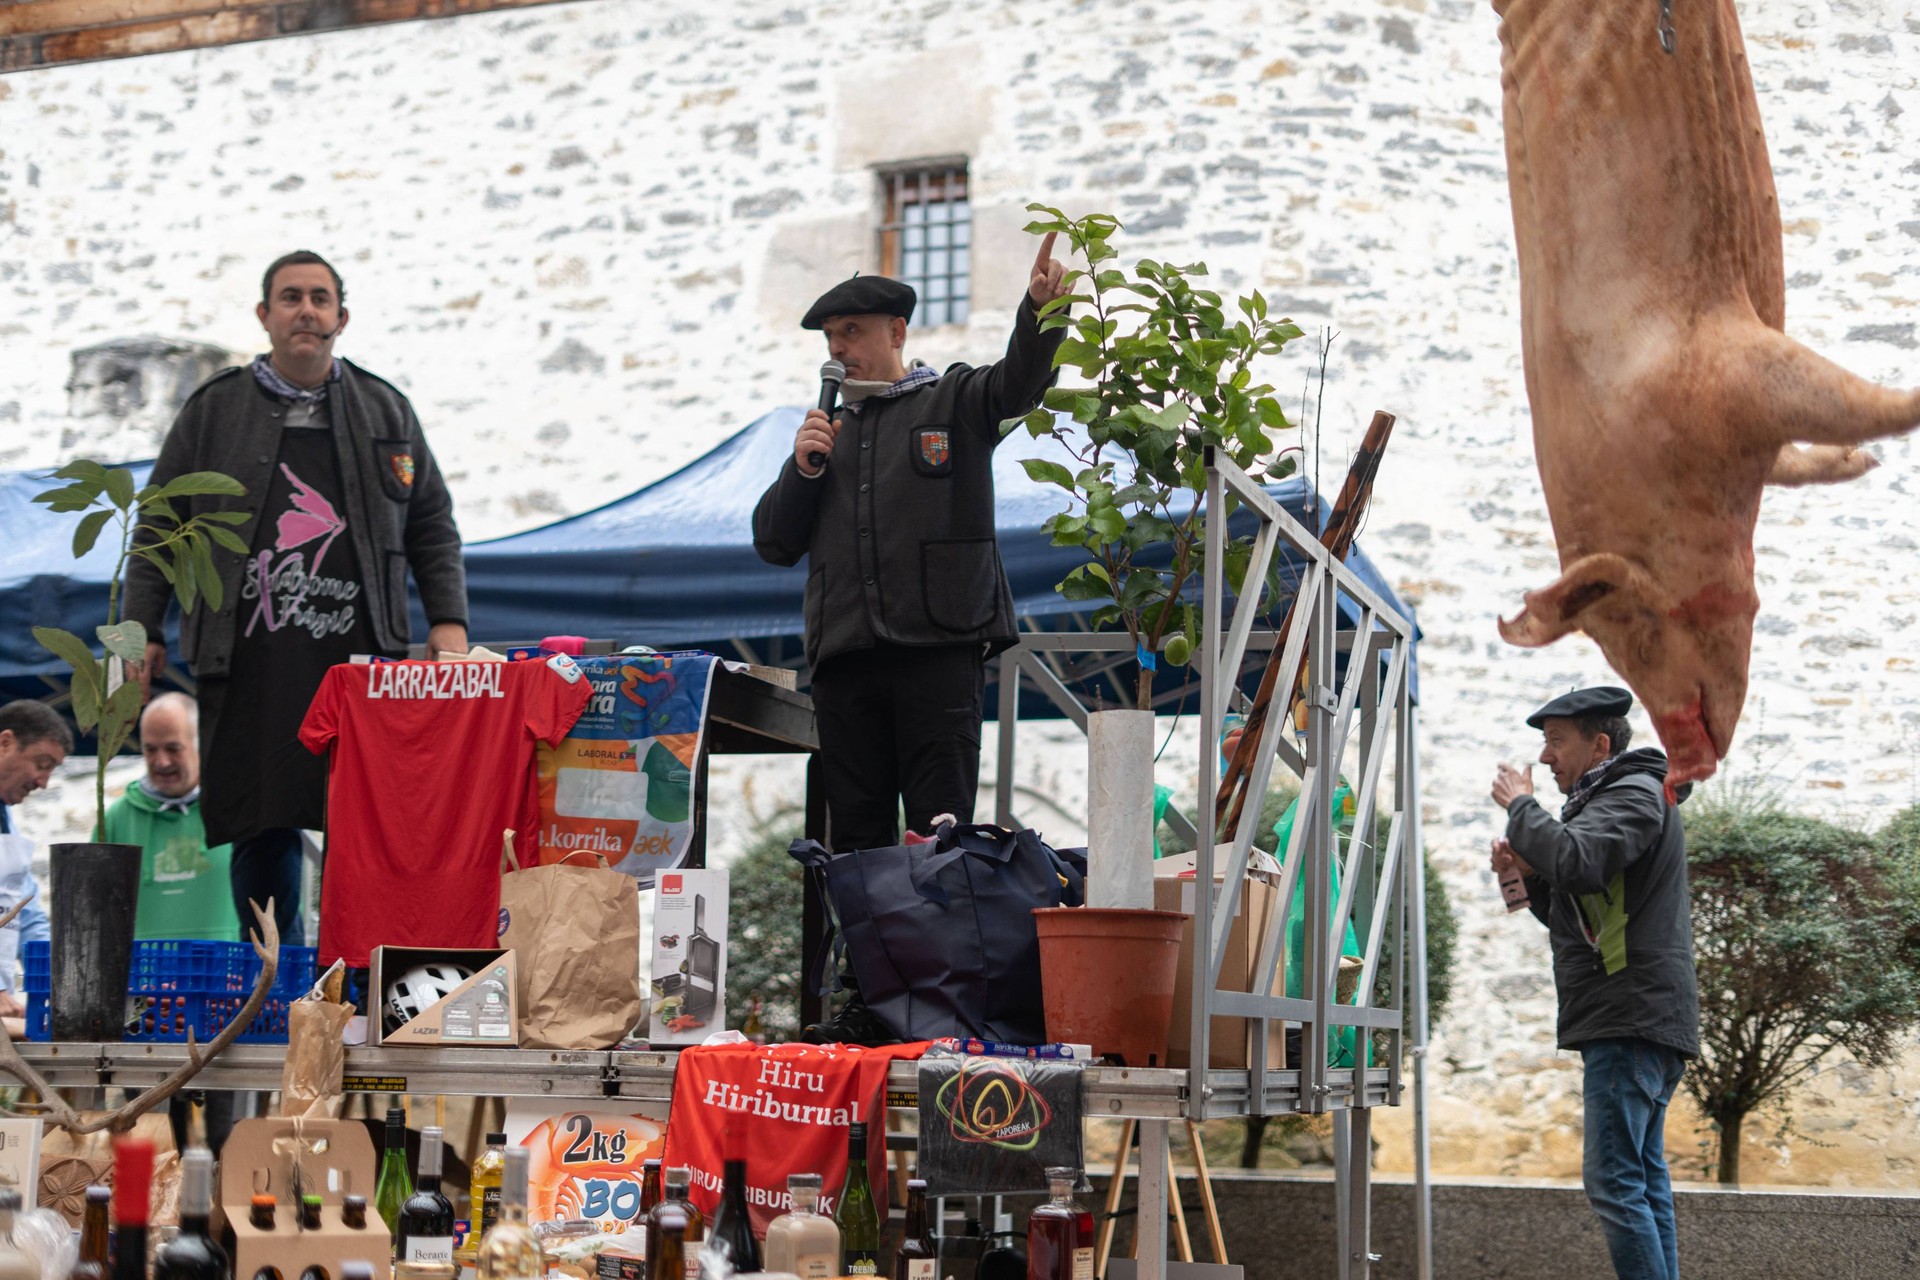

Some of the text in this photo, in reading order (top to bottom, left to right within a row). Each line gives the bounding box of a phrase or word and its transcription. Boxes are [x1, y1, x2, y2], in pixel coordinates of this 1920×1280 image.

[367, 663, 505, 699] LARRAZABAL
[589, 680, 617, 693] ara
[577, 749, 618, 759] LABORAL
[633, 829, 676, 856] aek
[412, 1027, 439, 1035] LAZER
[757, 1059, 825, 1093] Hiru
[995, 1121, 1031, 1138] ZAPOREAK
[564, 1115, 626, 1163] 2kg
[414, 1249, 449, 1260] Berarte
